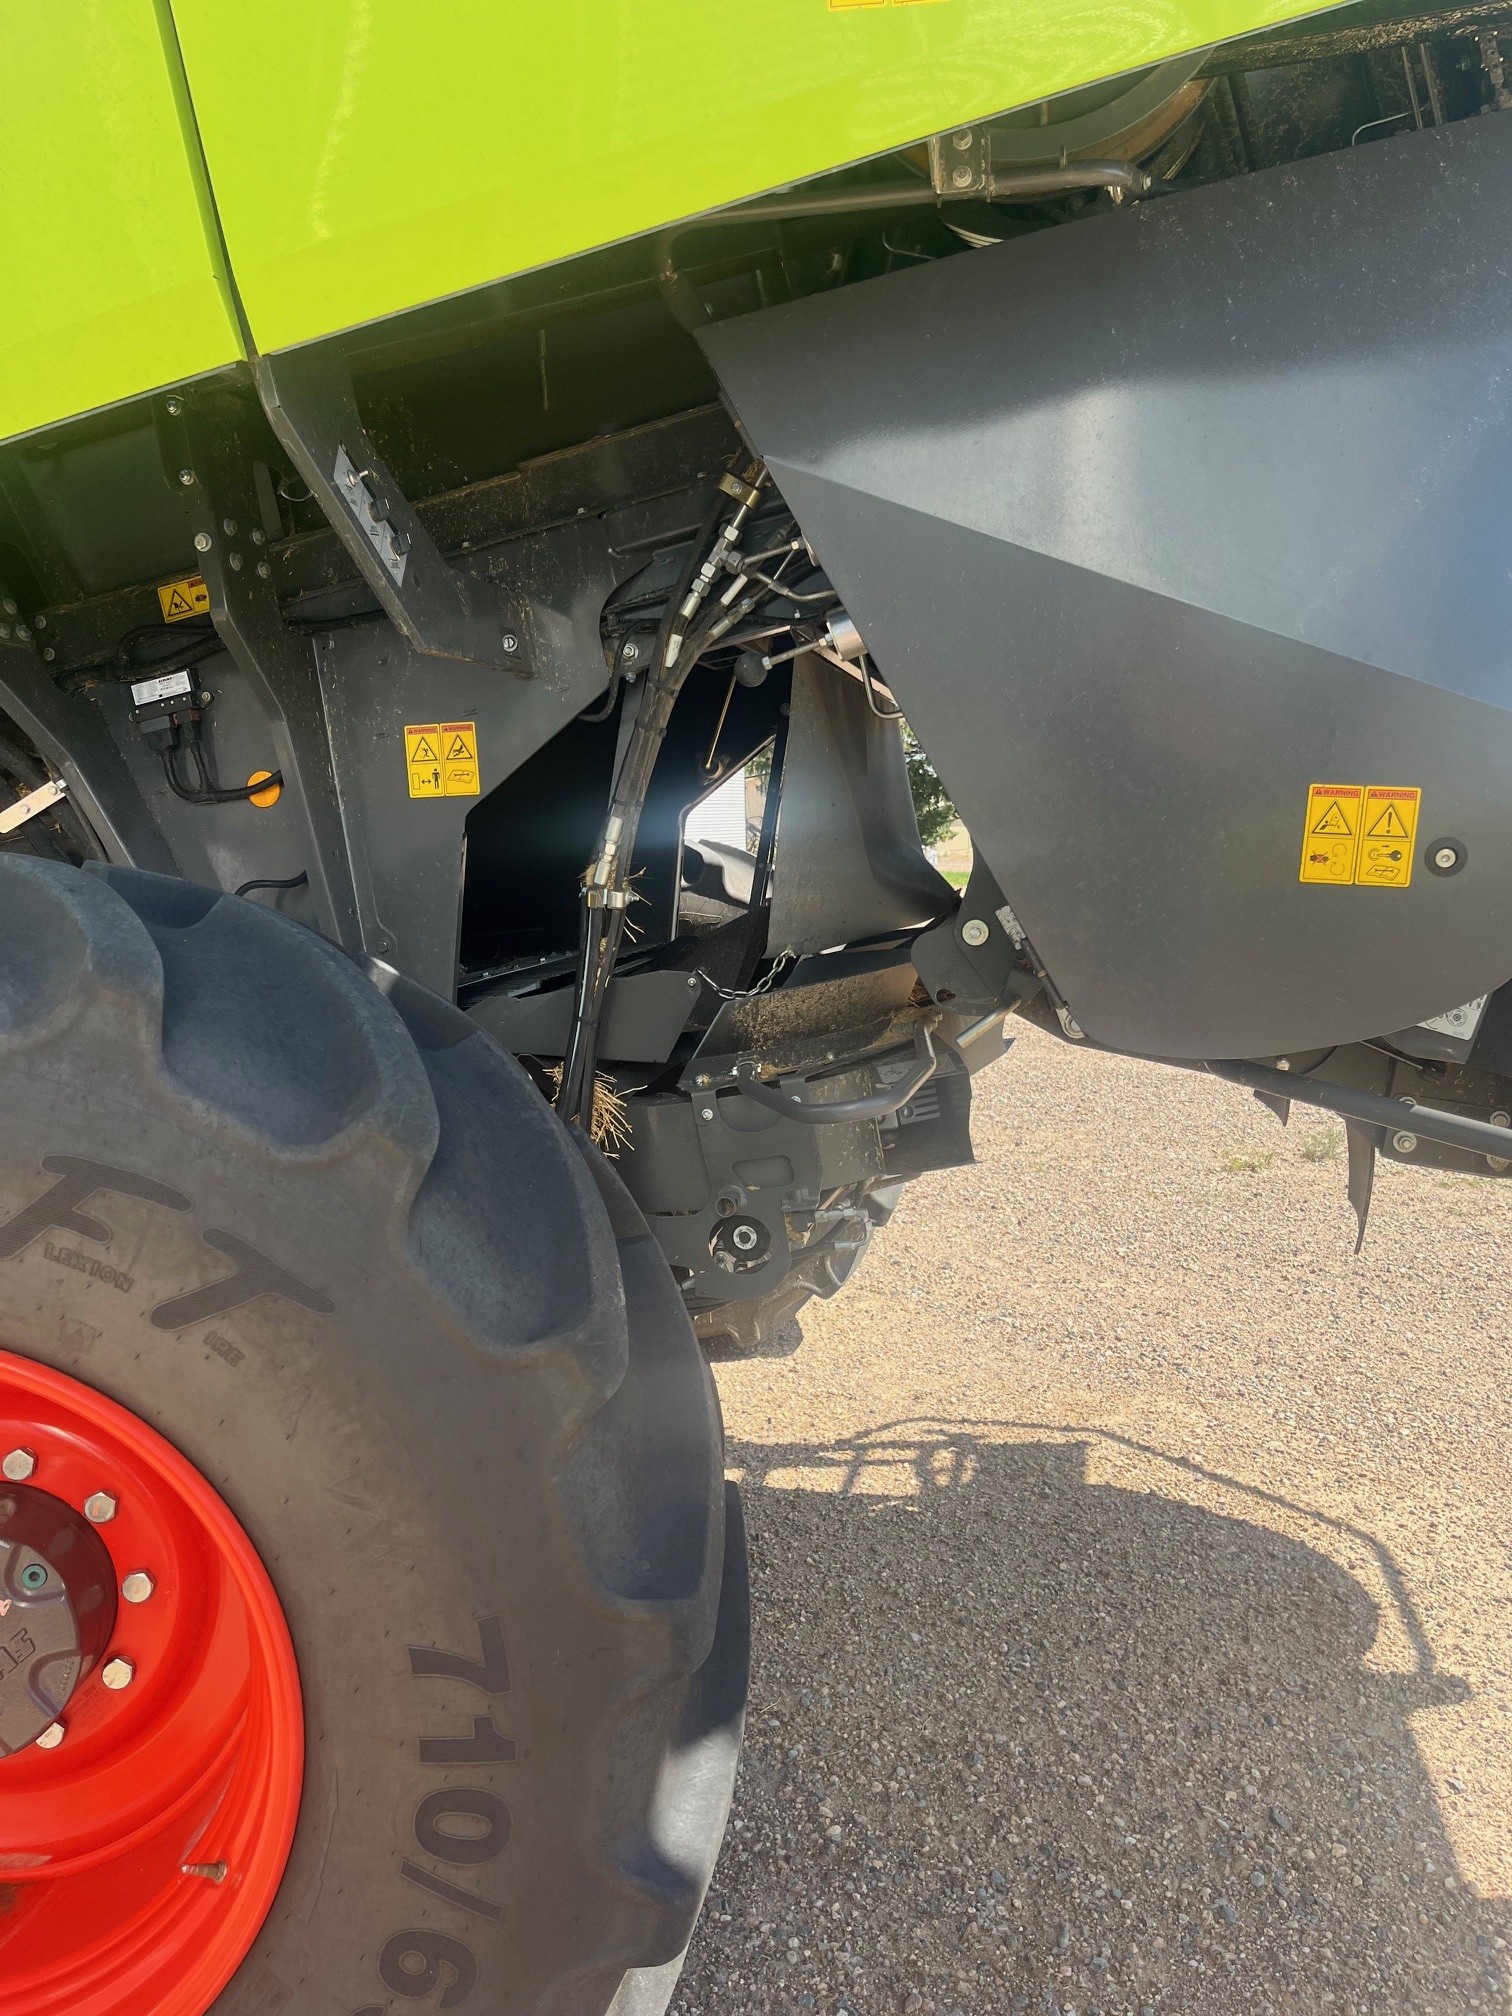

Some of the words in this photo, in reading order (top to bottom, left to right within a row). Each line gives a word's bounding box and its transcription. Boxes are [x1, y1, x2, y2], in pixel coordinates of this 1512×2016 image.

[1323, 789, 1359, 797] WARNING
[1379, 791, 1416, 799] WARNING
[44, 1241, 135, 1293] LEXION
[351, 1612, 518, 2016] 710/6
